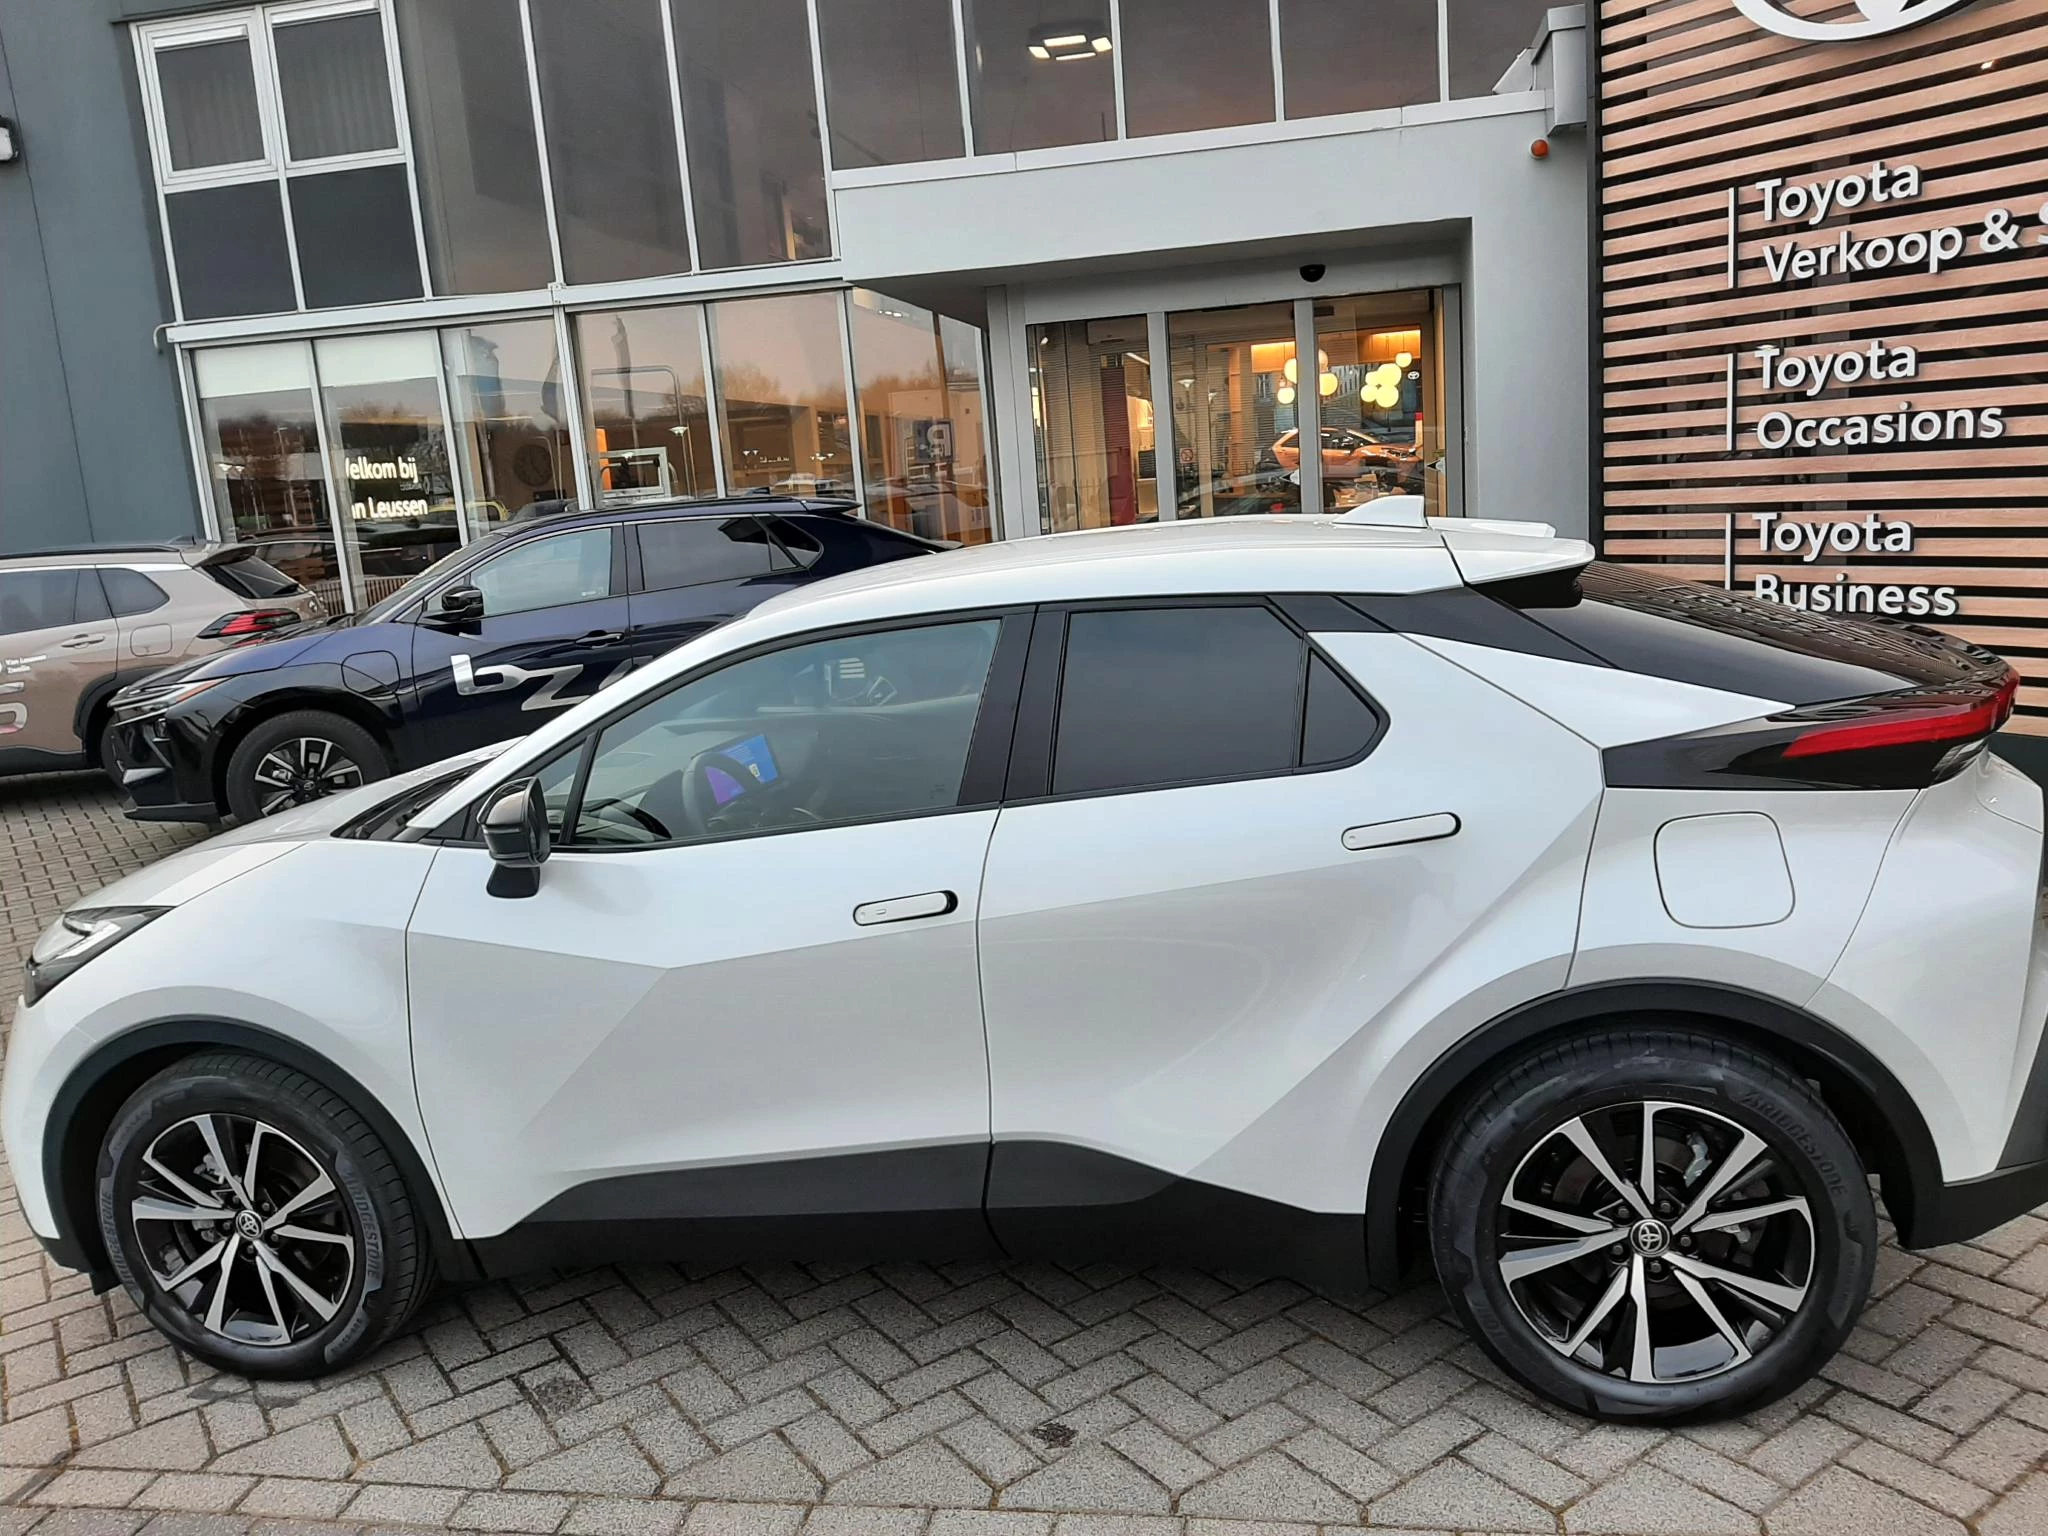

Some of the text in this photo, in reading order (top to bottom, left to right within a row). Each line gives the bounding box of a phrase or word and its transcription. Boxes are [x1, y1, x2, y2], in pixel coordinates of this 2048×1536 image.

[1755, 161, 1920, 225] Toyota
[1763, 226, 1963, 282] Verkoop
[1979, 208, 2020, 253] &
[1754, 340, 1916, 396] Toyota
[1757, 400, 2004, 449] Occasions
[398, 456, 419, 483] bij
[368, 496, 428, 518] Leussen
[1752, 513, 1911, 562] Toyota
[1755, 572, 1957, 616] Business
